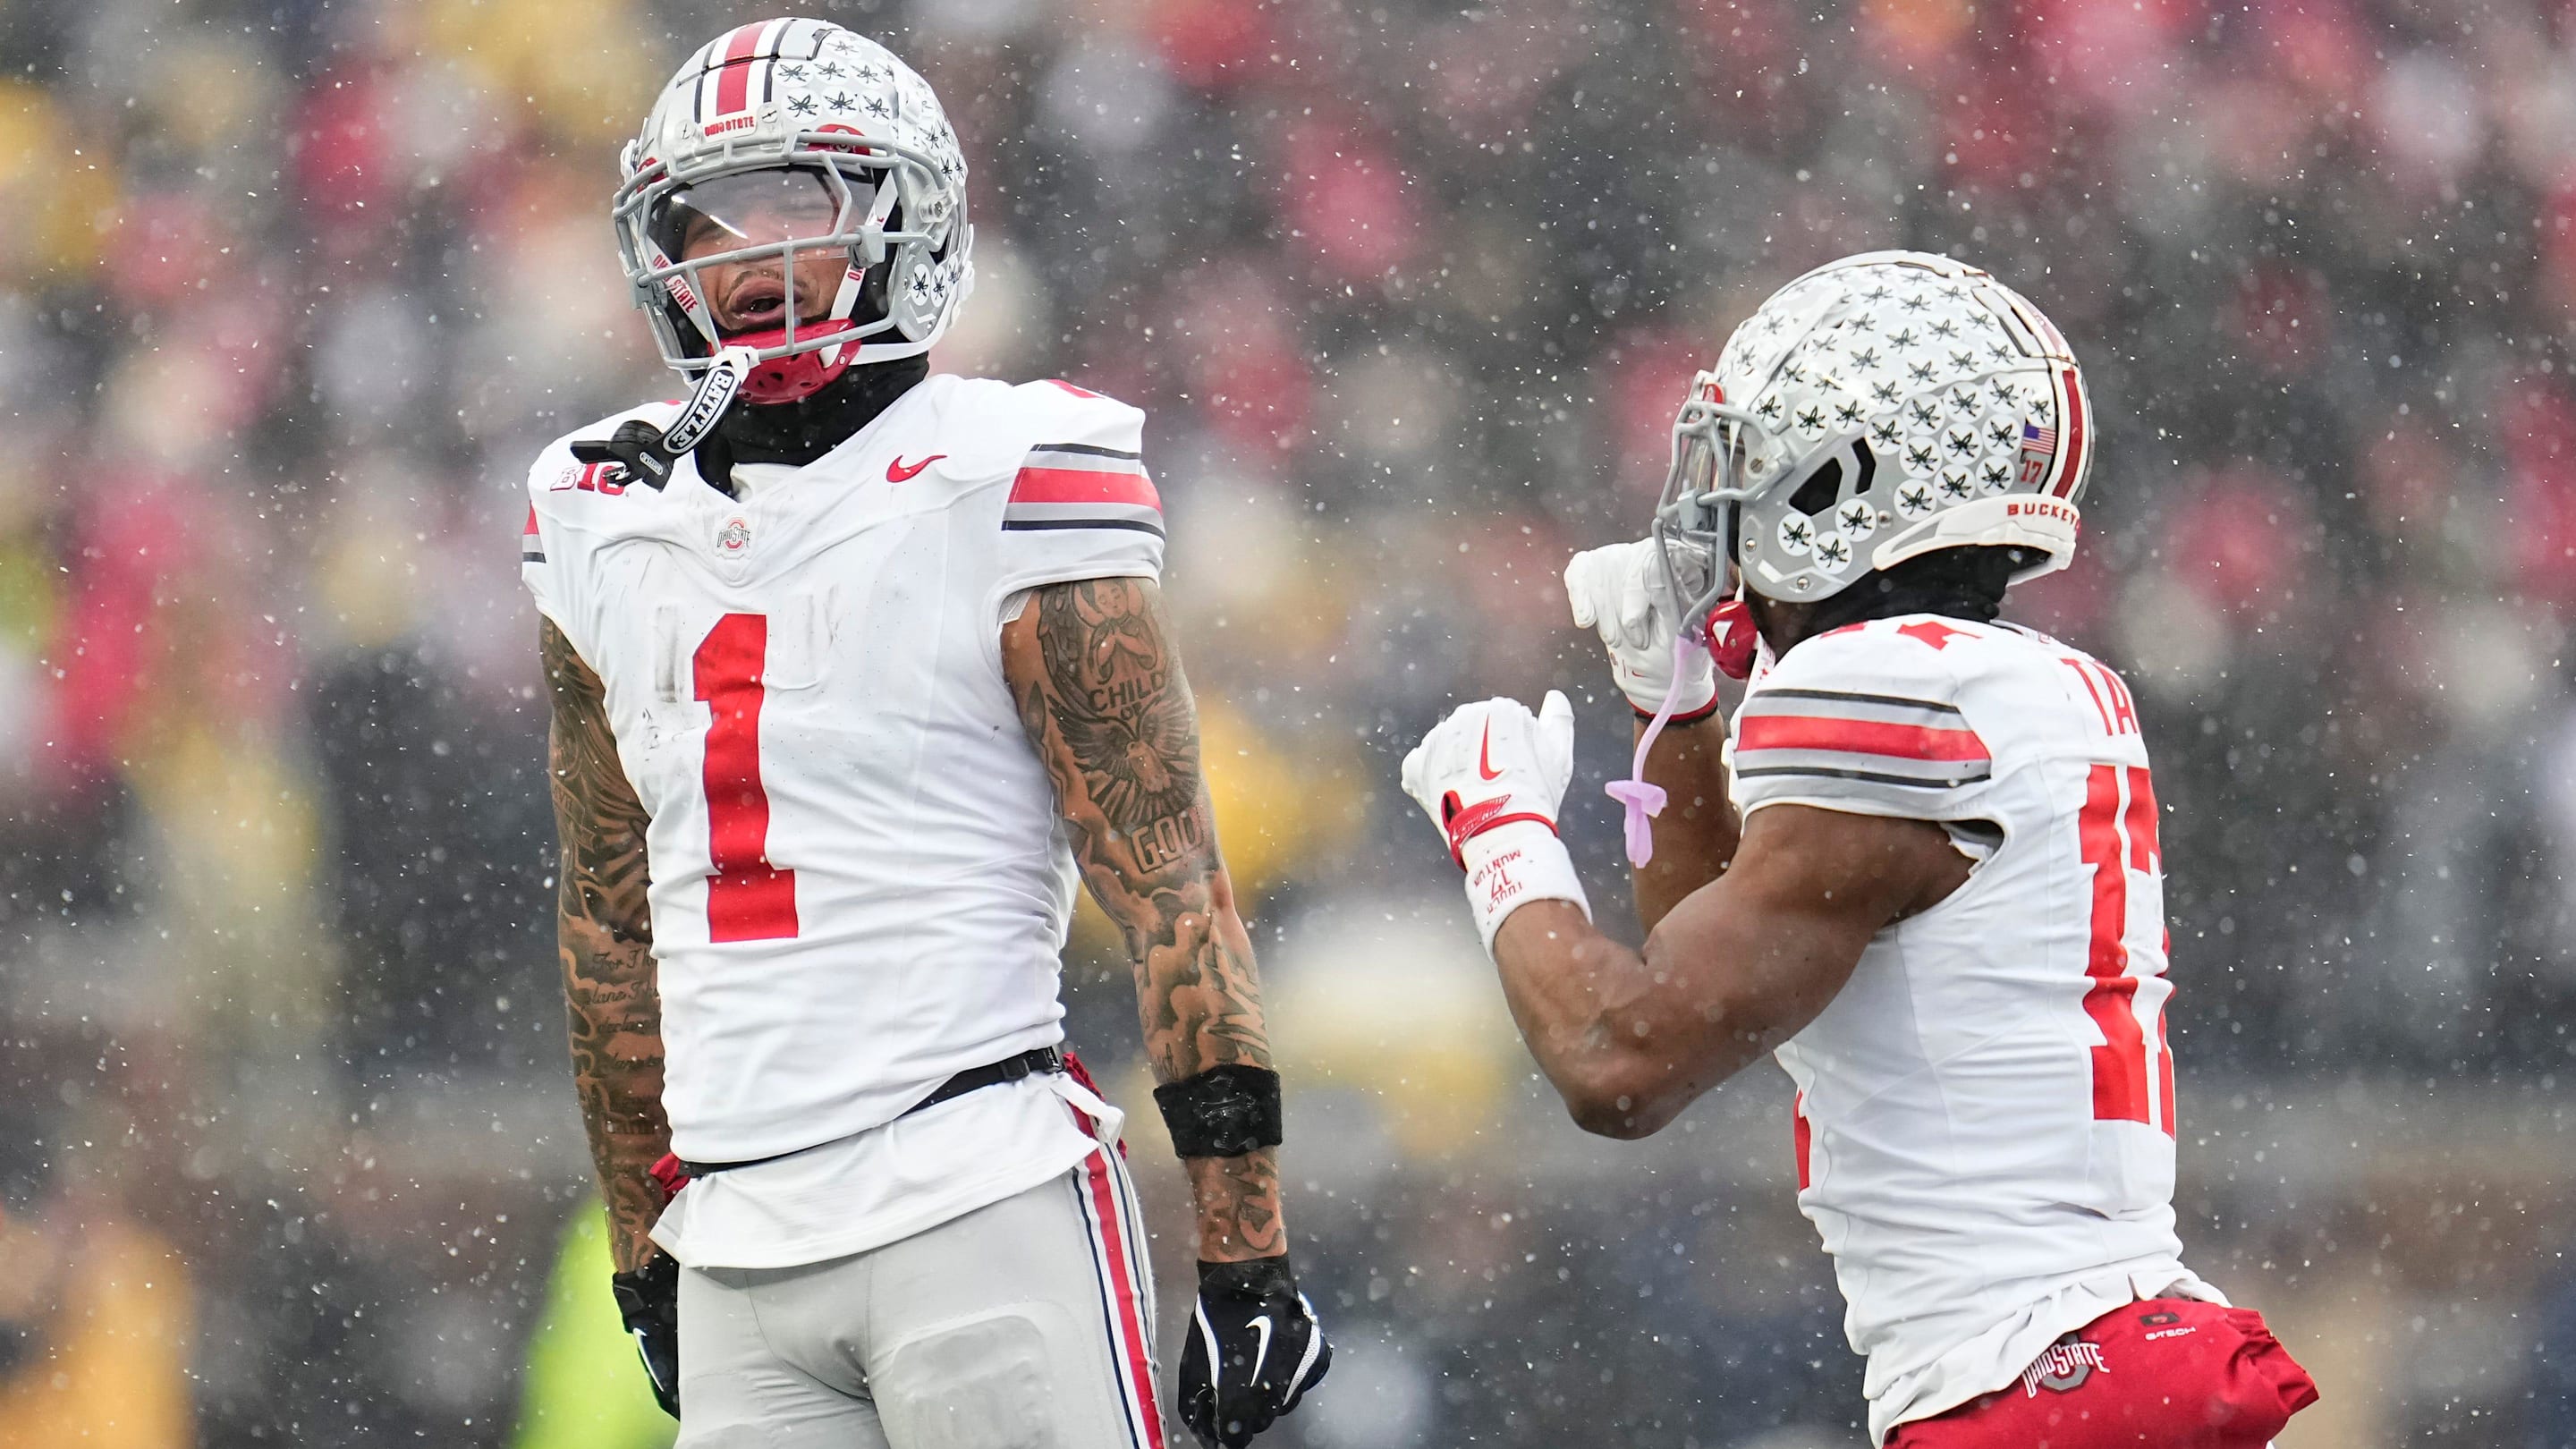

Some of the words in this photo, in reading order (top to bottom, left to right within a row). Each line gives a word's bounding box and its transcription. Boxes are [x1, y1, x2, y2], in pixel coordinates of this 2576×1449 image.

[705, 123, 724, 137] OHIO
[725, 116, 754, 131] STATE
[669, 278, 698, 313] STATE
[667, 370, 734, 448] BATTLE
[2020, 460, 2044, 484] 17
[1088, 671, 1166, 713] CHILD
[1121, 701, 1142, 721] OF
[692, 614, 798, 943] 1
[1130, 806, 1204, 874] GOD
[1491, 869, 1513, 900] 17
[2021, 1352, 2056, 1399] OHIO
[2050, 1343, 2110, 1376] STATE
